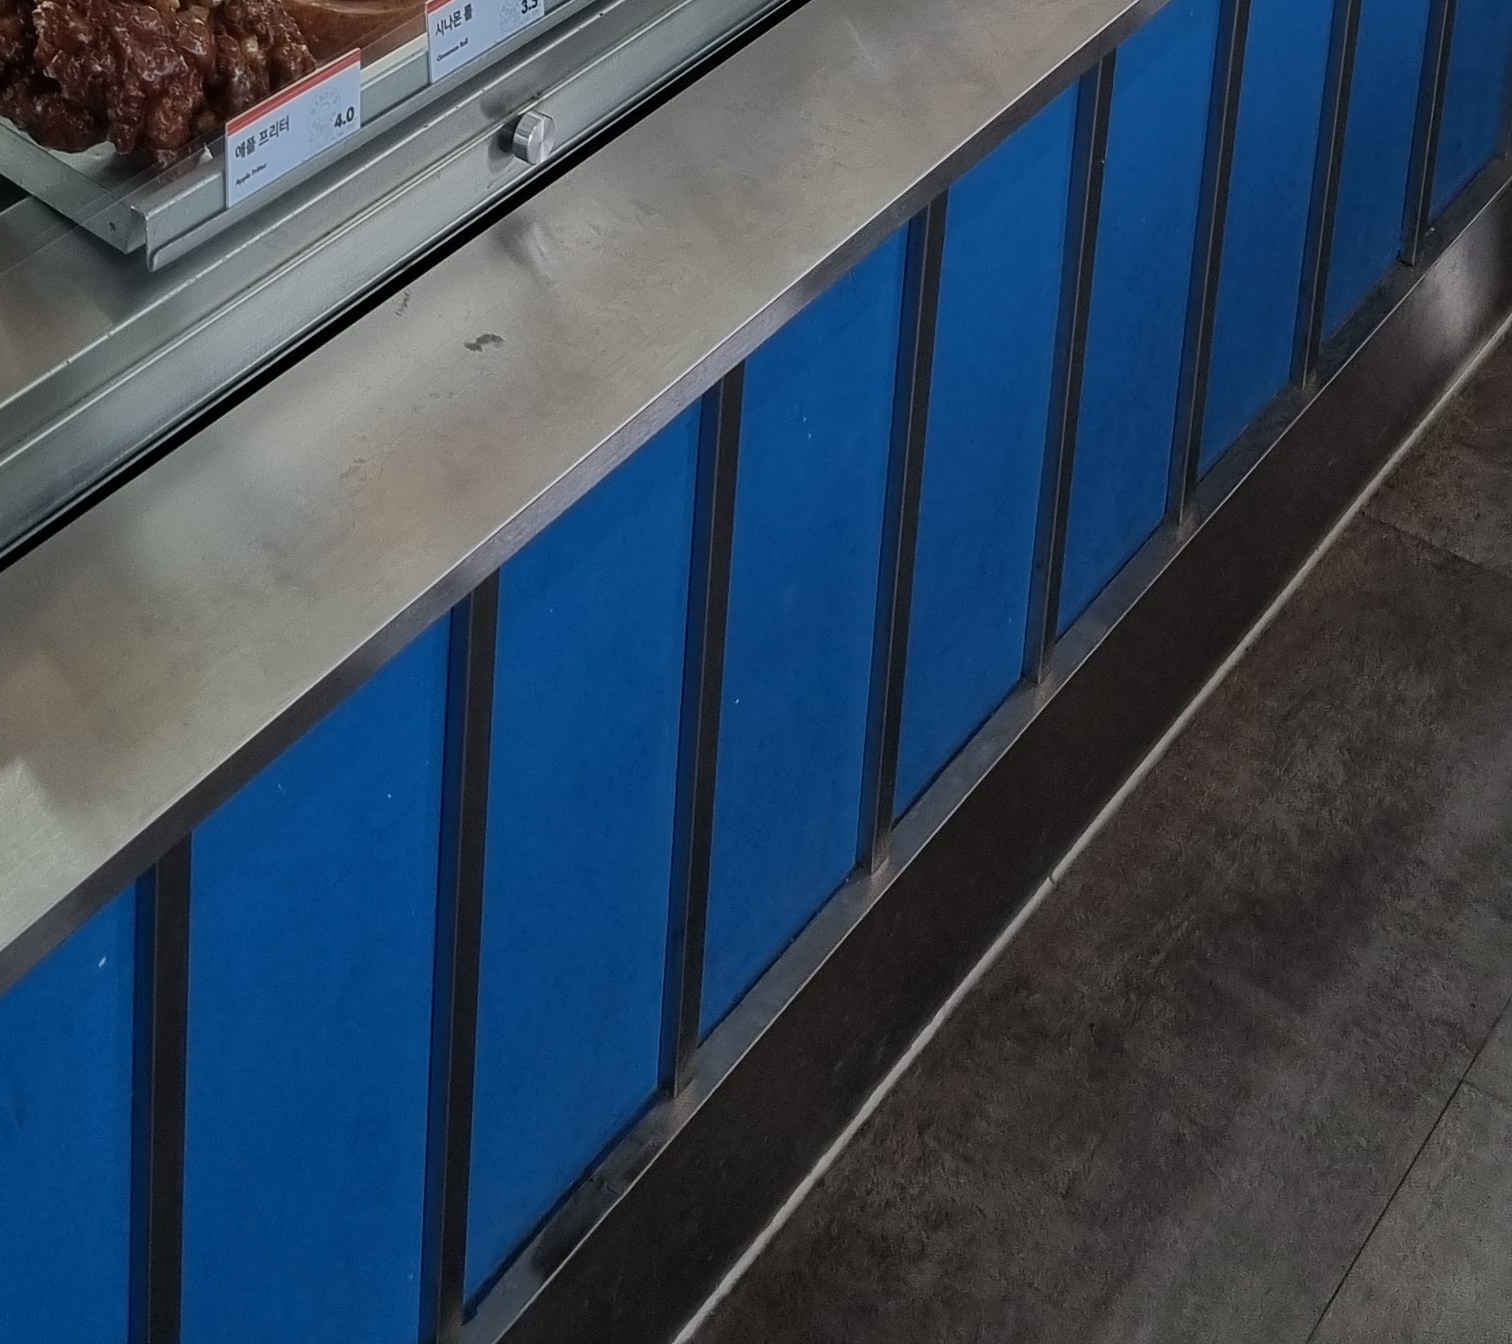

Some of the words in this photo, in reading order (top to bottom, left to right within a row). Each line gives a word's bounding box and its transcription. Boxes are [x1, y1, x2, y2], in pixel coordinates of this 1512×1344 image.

[435, 9, 463, 37] 시나몬
[333, 106, 356, 129] 4.0
[234, 134, 257, 159] 애플
[257, 114, 291, 148] 프리터
